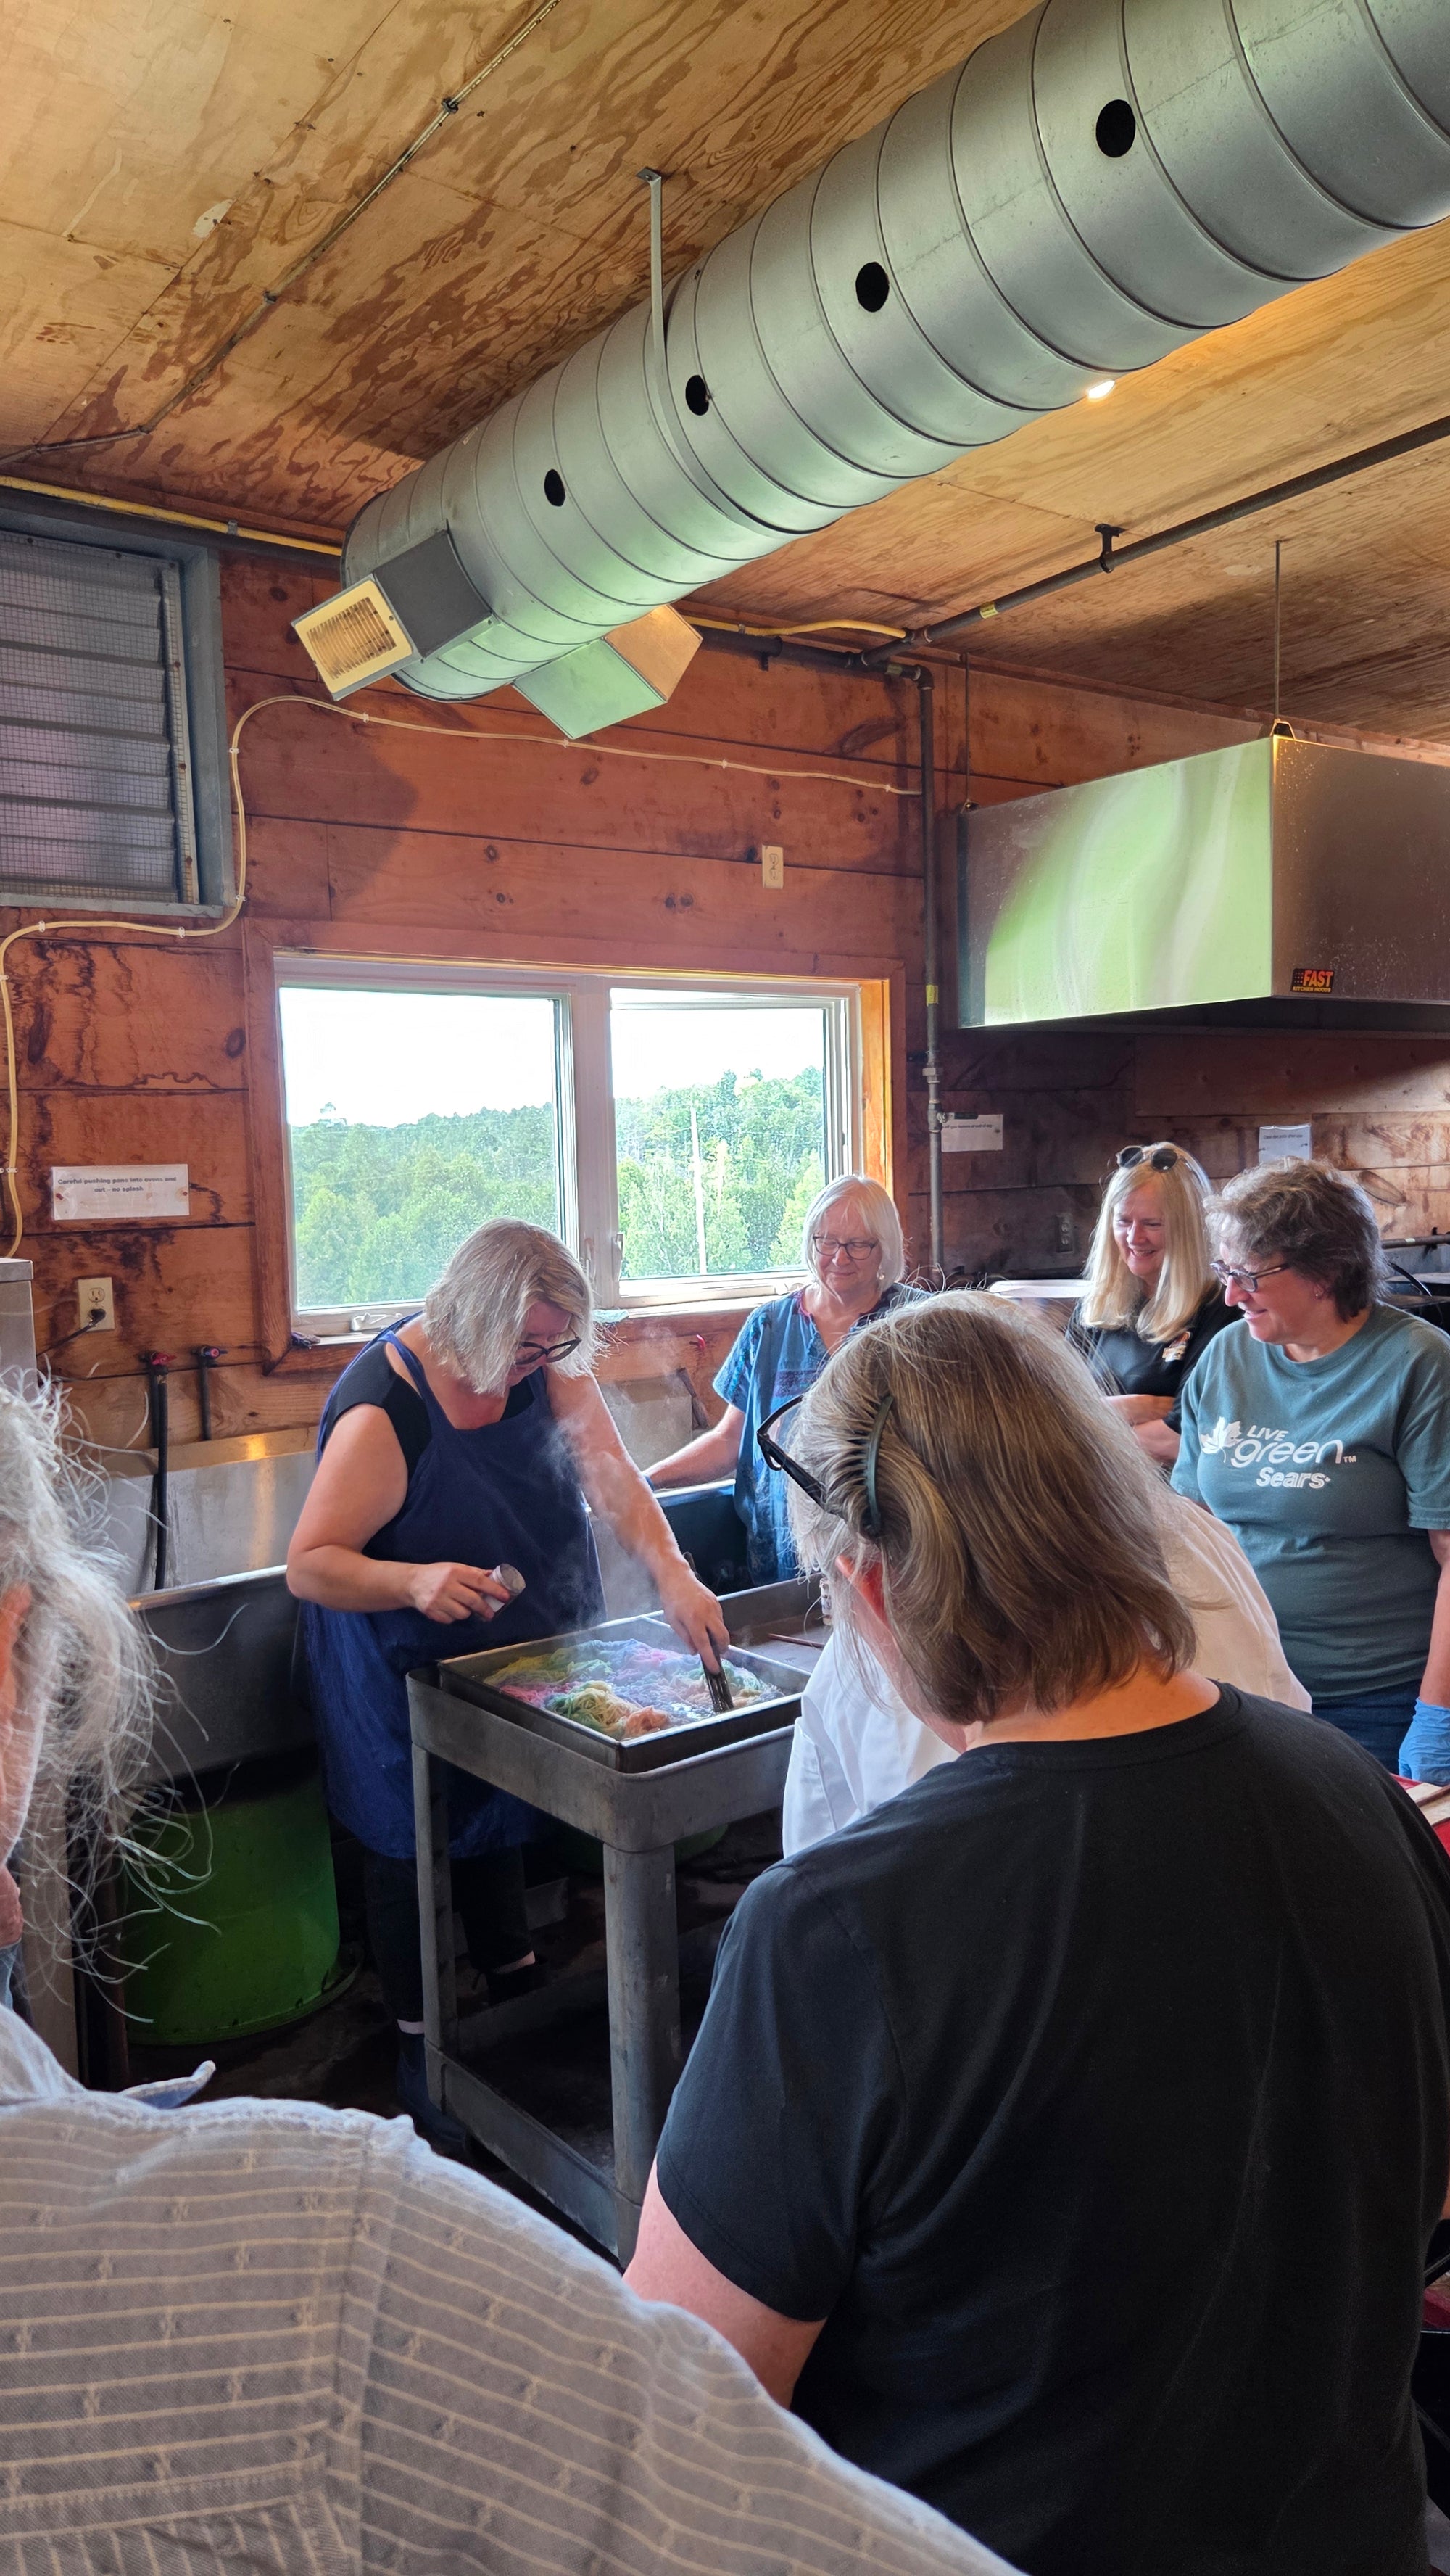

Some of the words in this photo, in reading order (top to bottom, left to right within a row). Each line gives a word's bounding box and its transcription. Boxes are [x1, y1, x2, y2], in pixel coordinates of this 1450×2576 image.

[1303, 970, 1333, 987] FAST
[1247, 1425, 1289, 1442] LIVE
[1230, 1439, 1343, 1468] green
[1256, 1466, 1327, 1489] Sears
